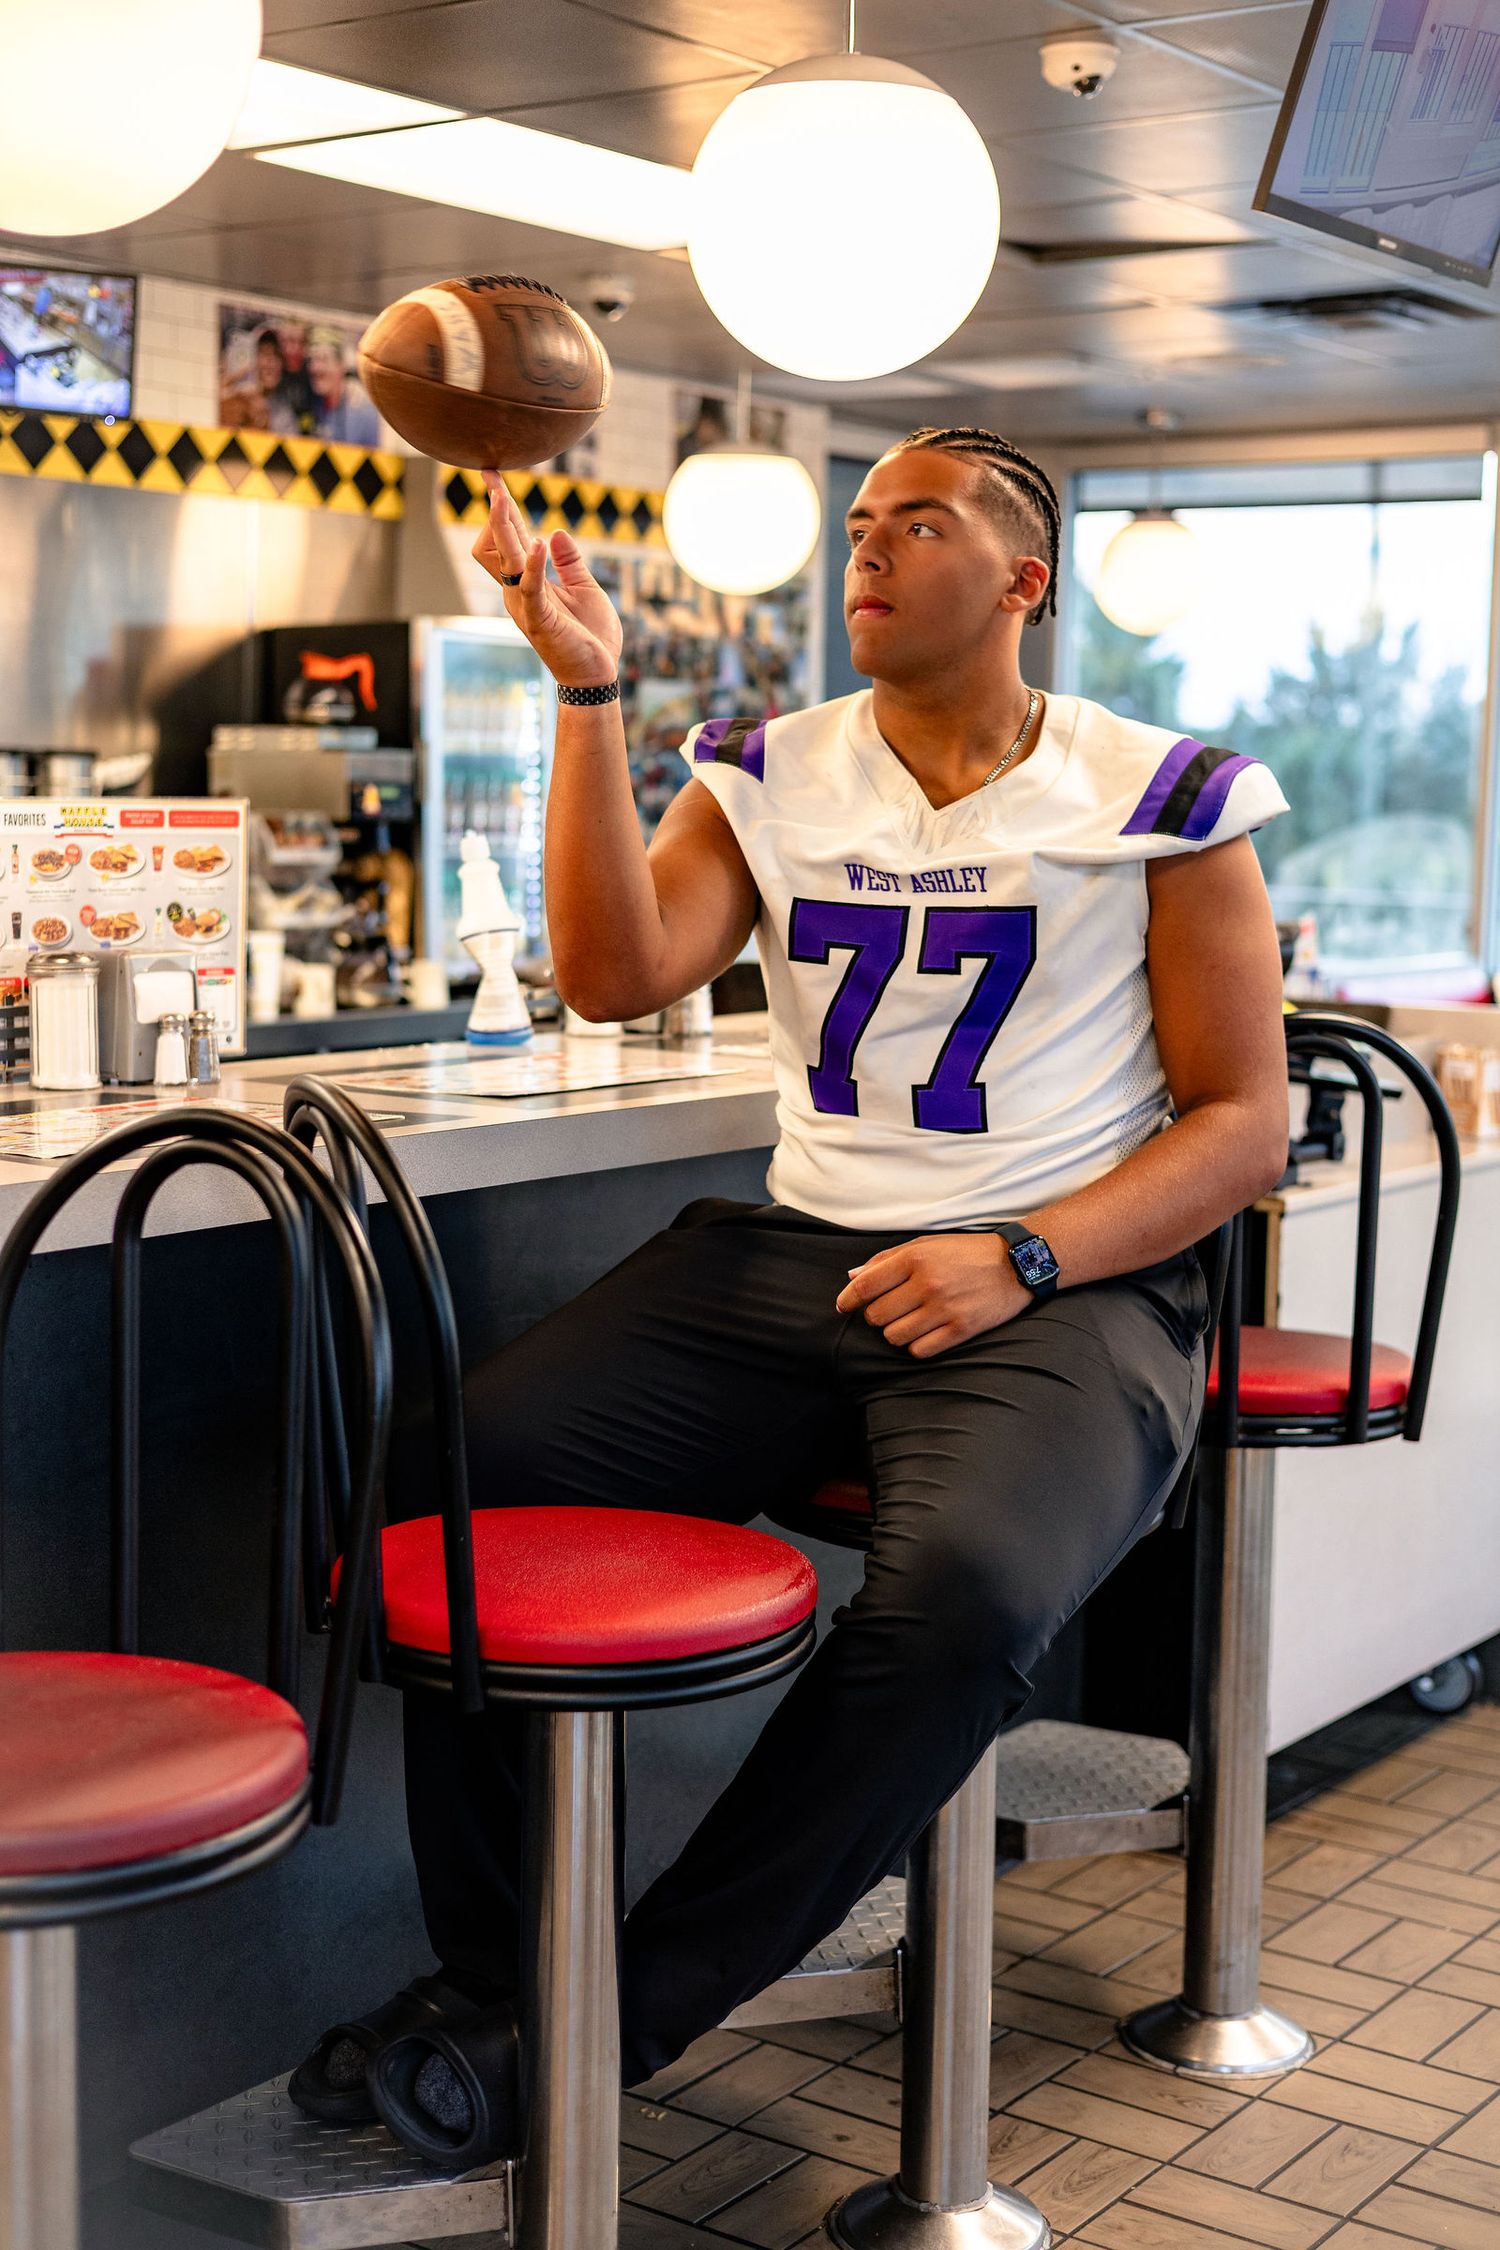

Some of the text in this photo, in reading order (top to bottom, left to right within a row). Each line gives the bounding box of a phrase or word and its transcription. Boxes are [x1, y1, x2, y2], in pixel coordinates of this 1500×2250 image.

[3, 813, 47, 826] FAVORITES
[64, 818, 104, 827] HOUSE
[844, 863, 988, 893] WEST ASHLEY
[787, 896, 1038, 1134] 77
